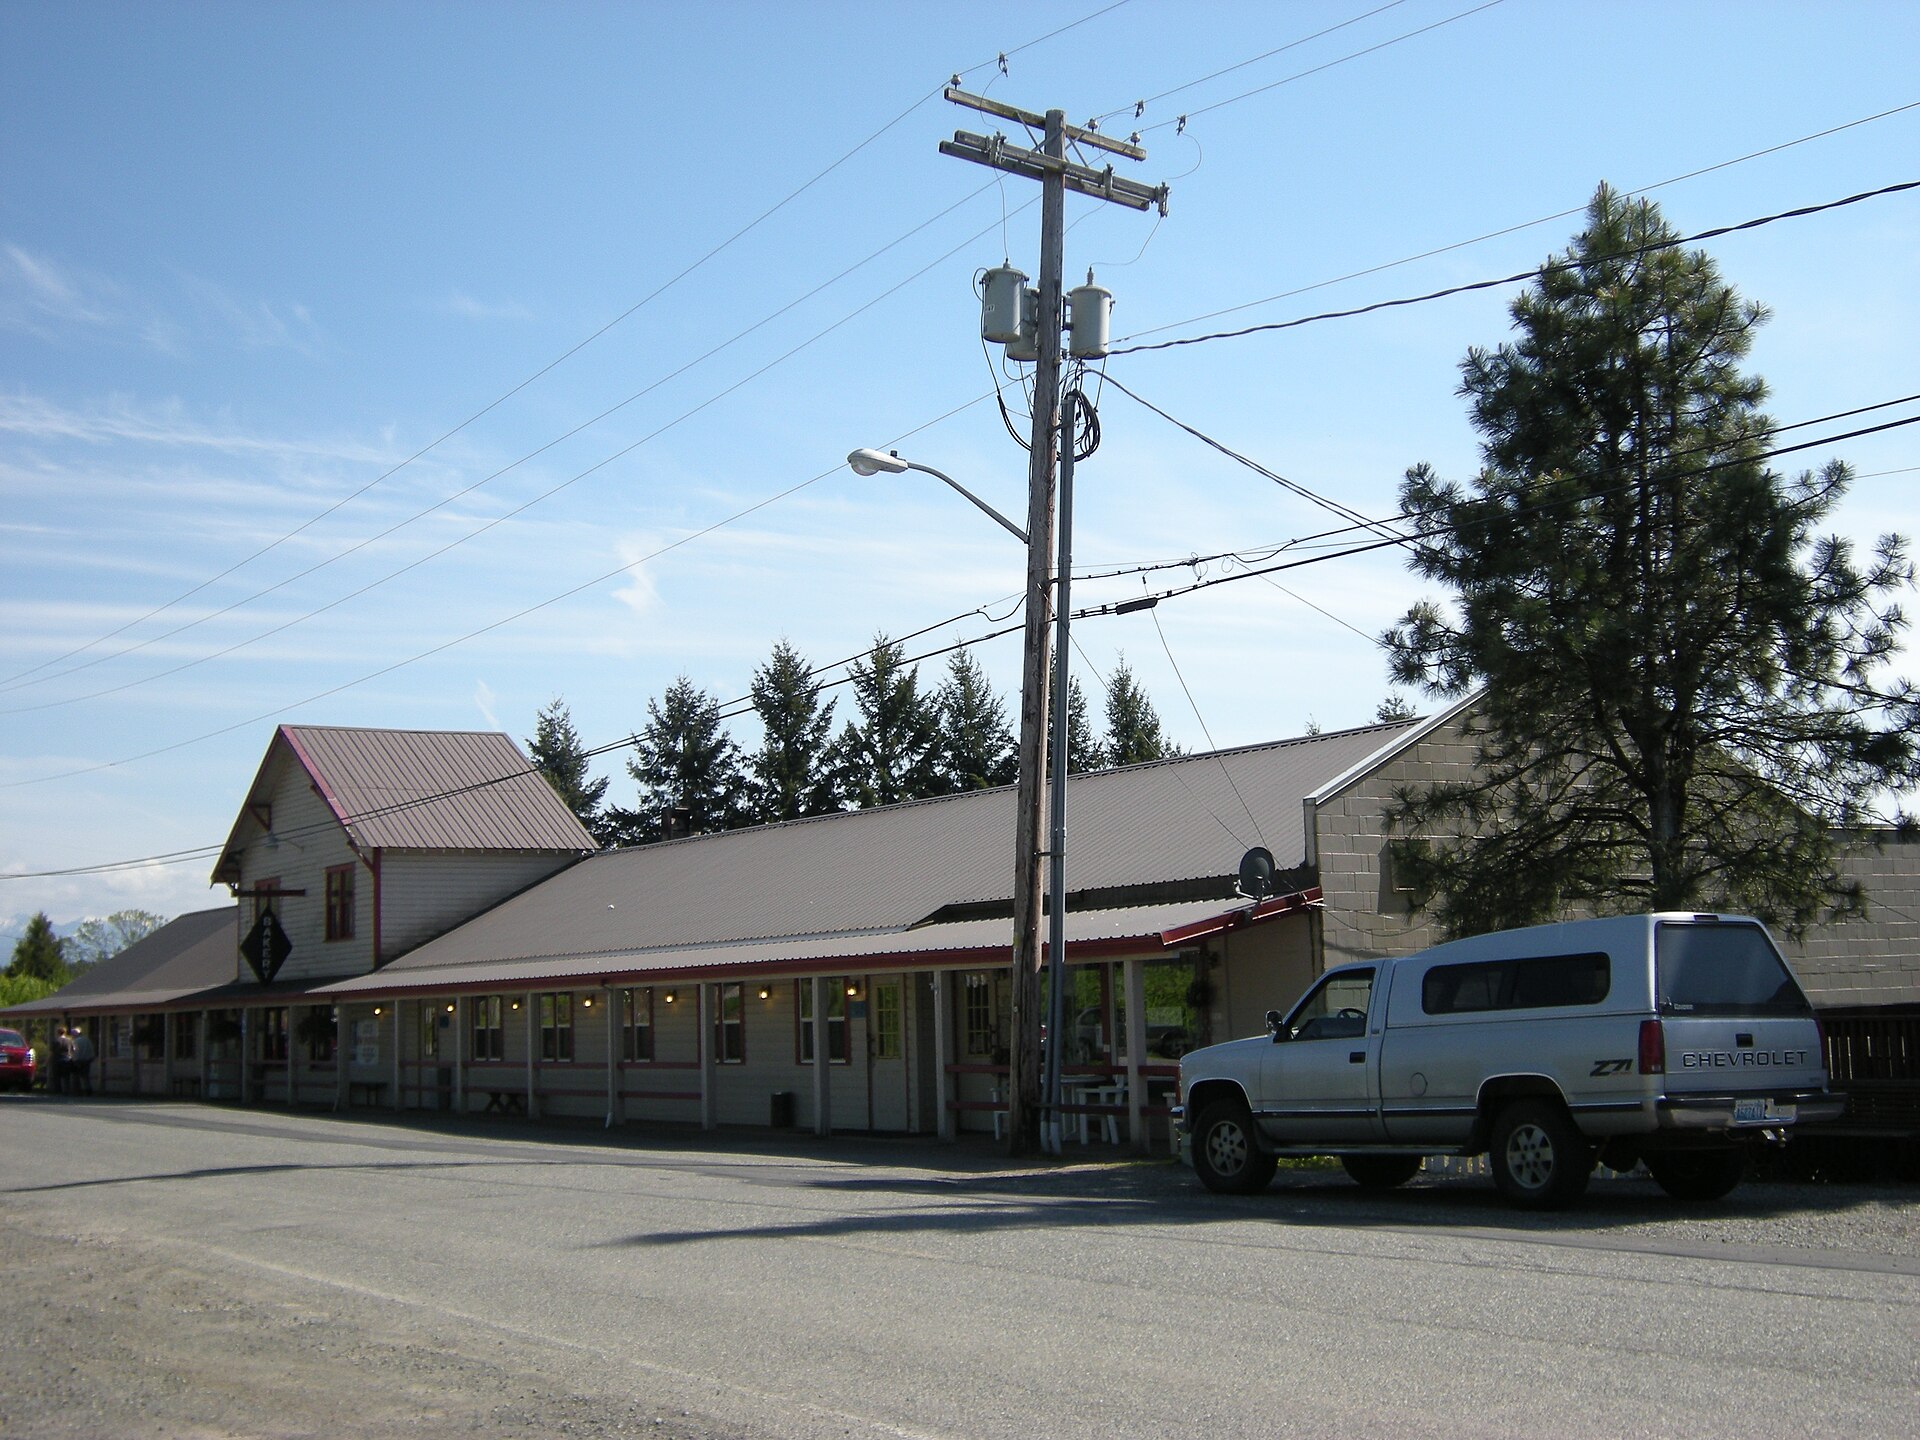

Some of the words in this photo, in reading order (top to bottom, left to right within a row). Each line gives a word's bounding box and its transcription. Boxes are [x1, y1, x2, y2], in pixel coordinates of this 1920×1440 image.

[262, 916, 271, 979] BAKERY
[1590, 1058, 1633, 1077] Z71
[1682, 1051, 1807, 1068] CHEVROLET
